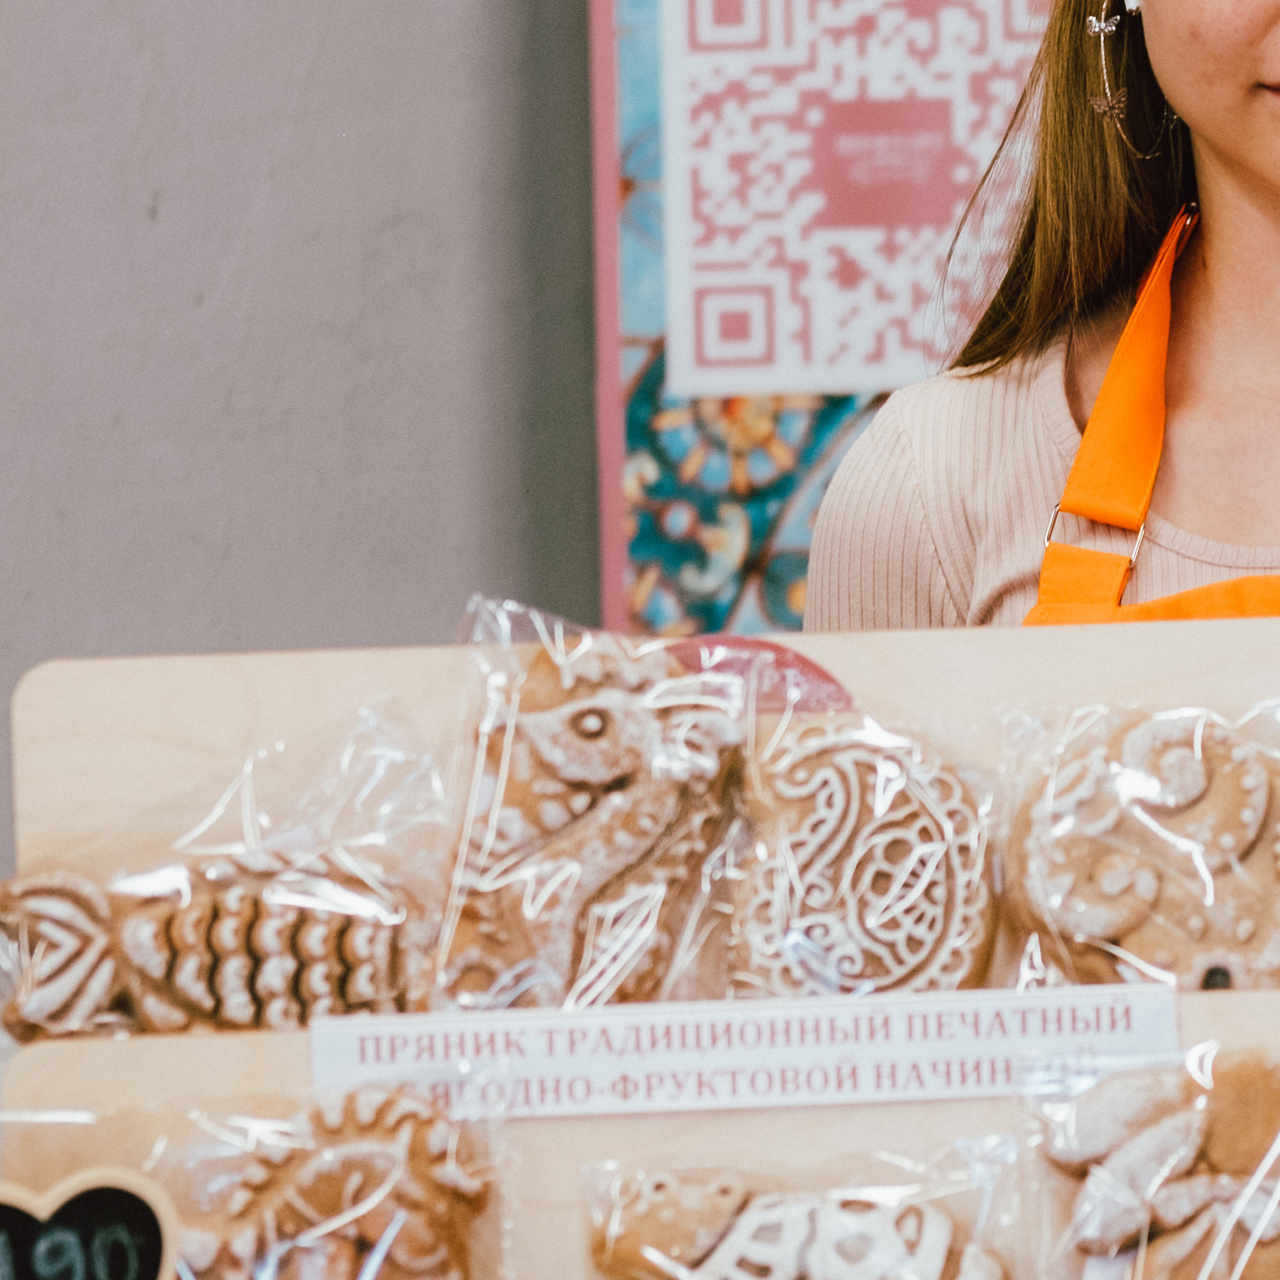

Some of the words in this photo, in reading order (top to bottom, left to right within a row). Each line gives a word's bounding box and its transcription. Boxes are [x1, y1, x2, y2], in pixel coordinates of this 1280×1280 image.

[356, 1030, 527, 1067] ПРЯНИК
[539, 1008, 892, 1063] ТРАДИЦИОННЫЙ
[905, 995, 1134, 1044] ПЕЧАТНЫЙ
